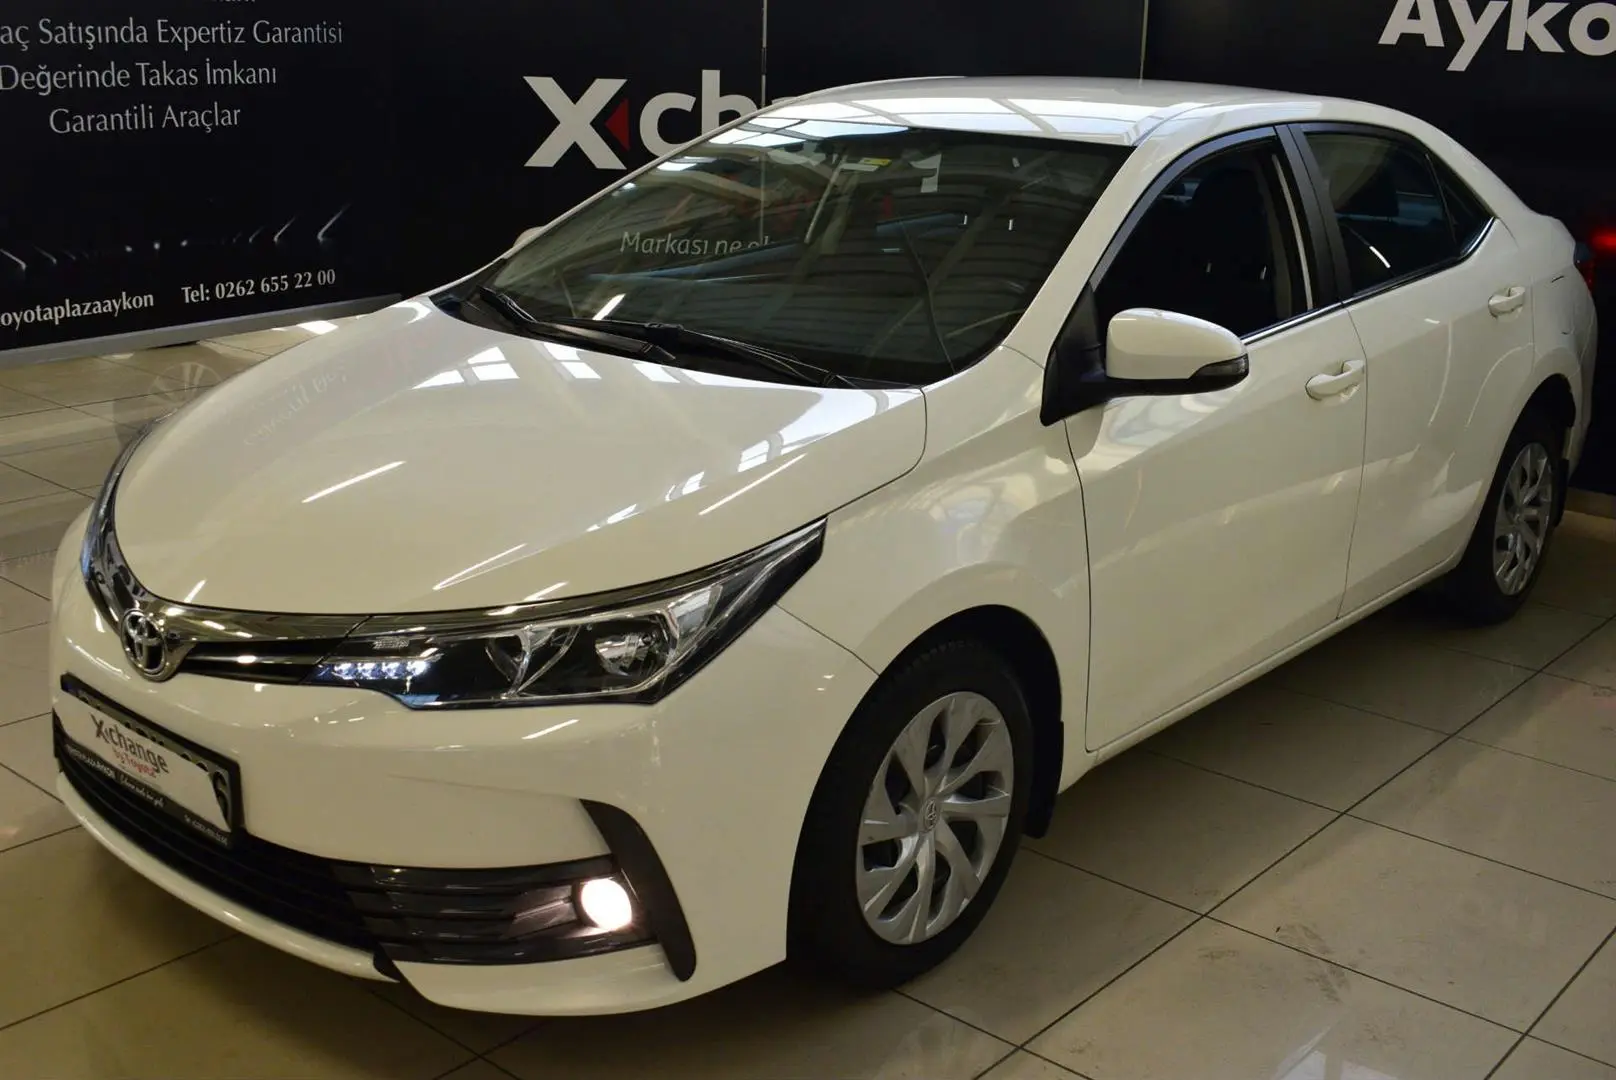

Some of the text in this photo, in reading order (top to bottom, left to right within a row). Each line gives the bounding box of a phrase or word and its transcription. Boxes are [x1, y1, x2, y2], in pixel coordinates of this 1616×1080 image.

[0, 16, 343, 52] aç Satışında Expertiz Garantisi
[0, 57, 277, 96] Değerinde Takas İmkanı
[49, 101, 241, 134] Garantili Araçlar
[522, 69, 790, 171] Xch
[619, 231, 708, 255] Markası
[0, 269, 336, 331] oyotaplazaaykon Tel: 0262 655 22 00
